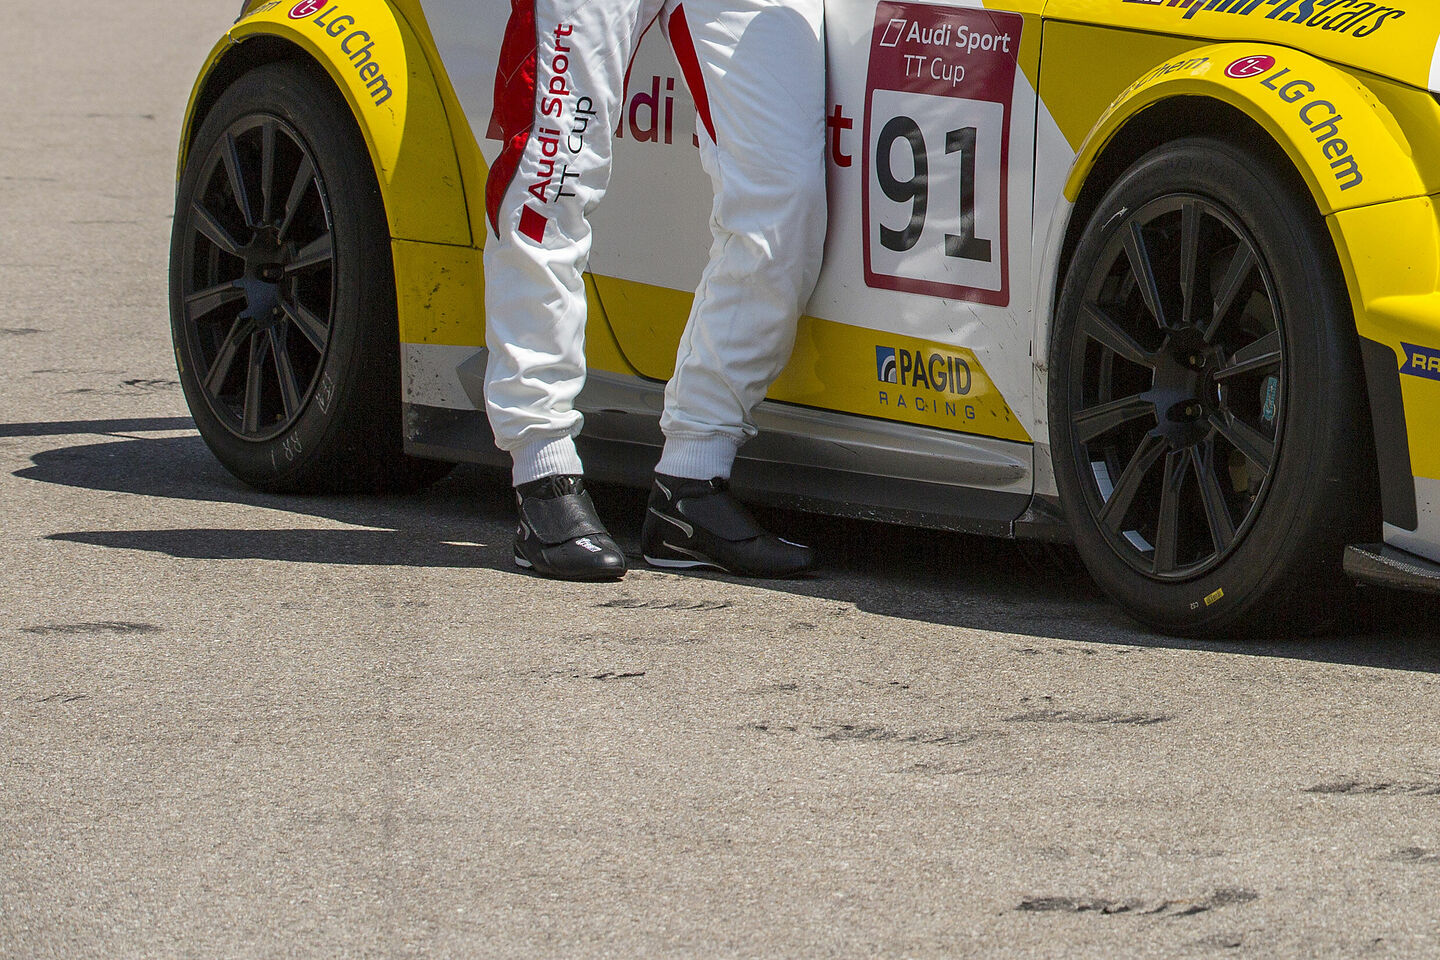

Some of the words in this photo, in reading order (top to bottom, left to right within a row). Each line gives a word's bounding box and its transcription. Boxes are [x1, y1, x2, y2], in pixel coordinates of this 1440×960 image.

[313, 5, 355, 38] LG
[341, 30, 393, 107] Chem
[541, 24, 573, 117] Sport
[904, 54, 927, 77] TT
[930, 57, 965, 87] Cup
[905, 21, 952, 46] Audi
[955, 25, 1011, 54] Sport
[528, 127, 560, 203] Audi
[554, 164, 580, 202] TT
[568, 96, 597, 154] Cup
[1260, 67, 1316, 103] LG
[1299, 99, 1363, 192] Chem
[875, 116, 993, 263] 91
[879, 391, 976, 420] RACING
[899, 349, 972, 395] PAGID
